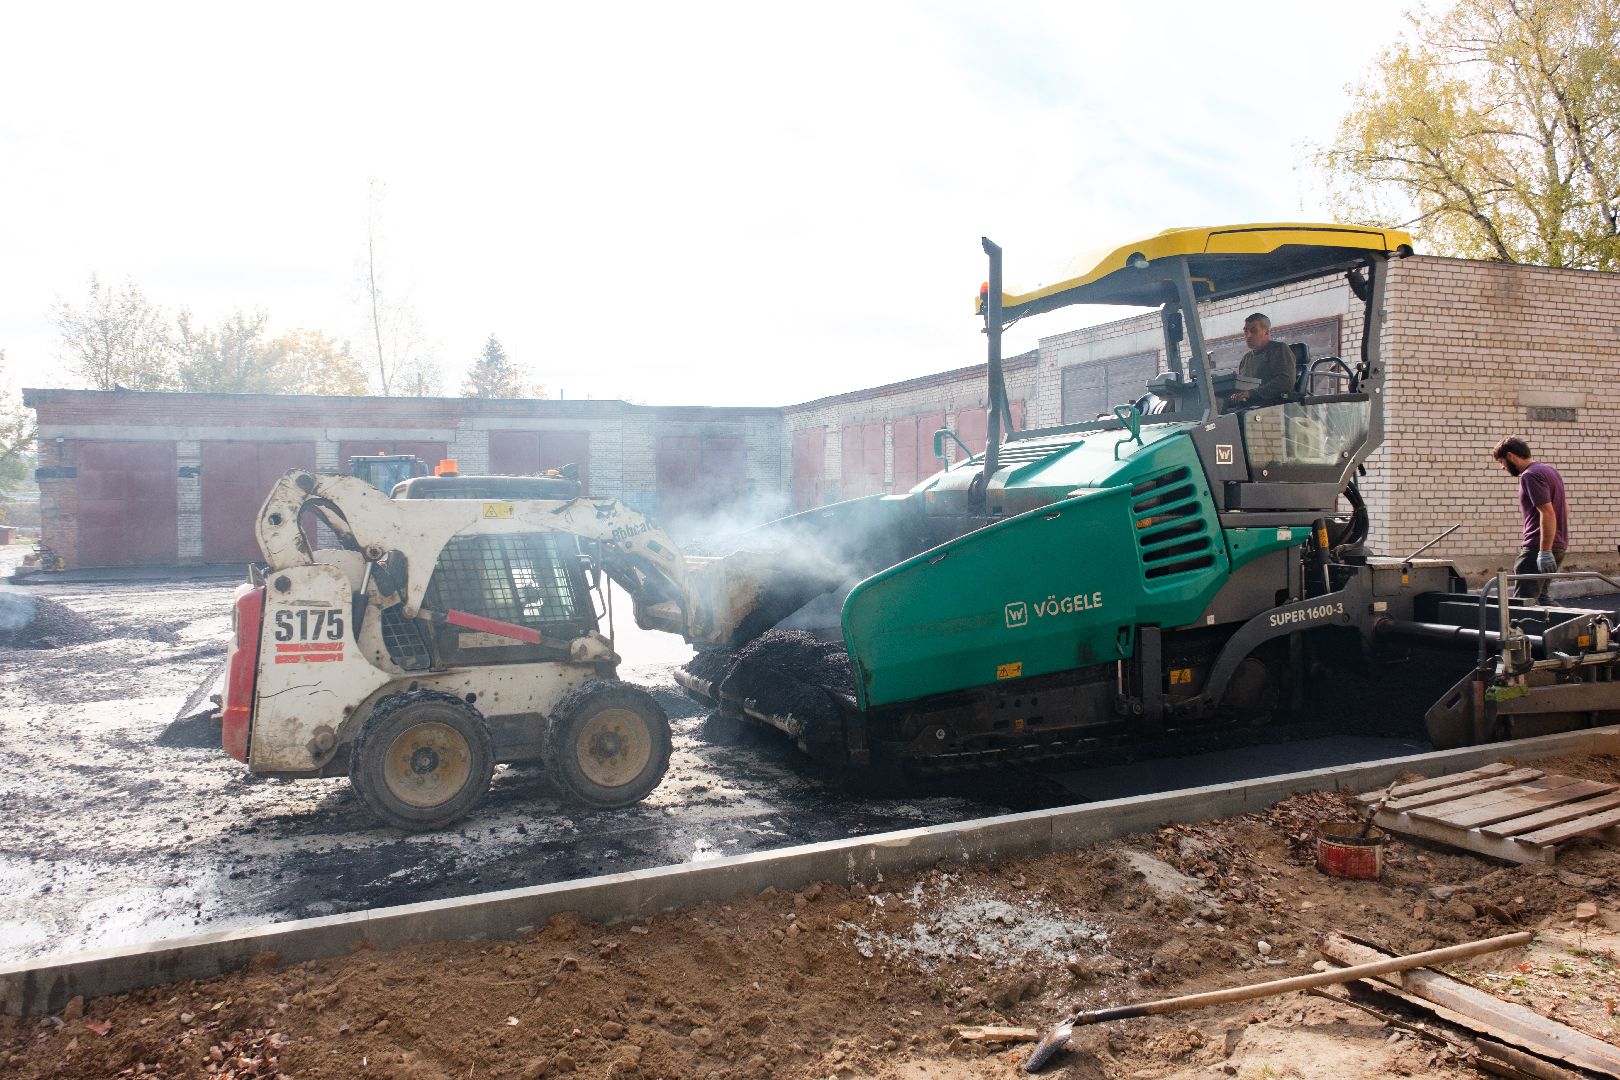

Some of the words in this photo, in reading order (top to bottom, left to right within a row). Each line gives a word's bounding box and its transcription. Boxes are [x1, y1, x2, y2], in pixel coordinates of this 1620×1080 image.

[1033, 591, 1103, 618] VÖGELE
[1269, 609, 1306, 627] SUPER
[1306, 602, 1345, 620] 1600-3
[274, 609, 344, 642] S175
